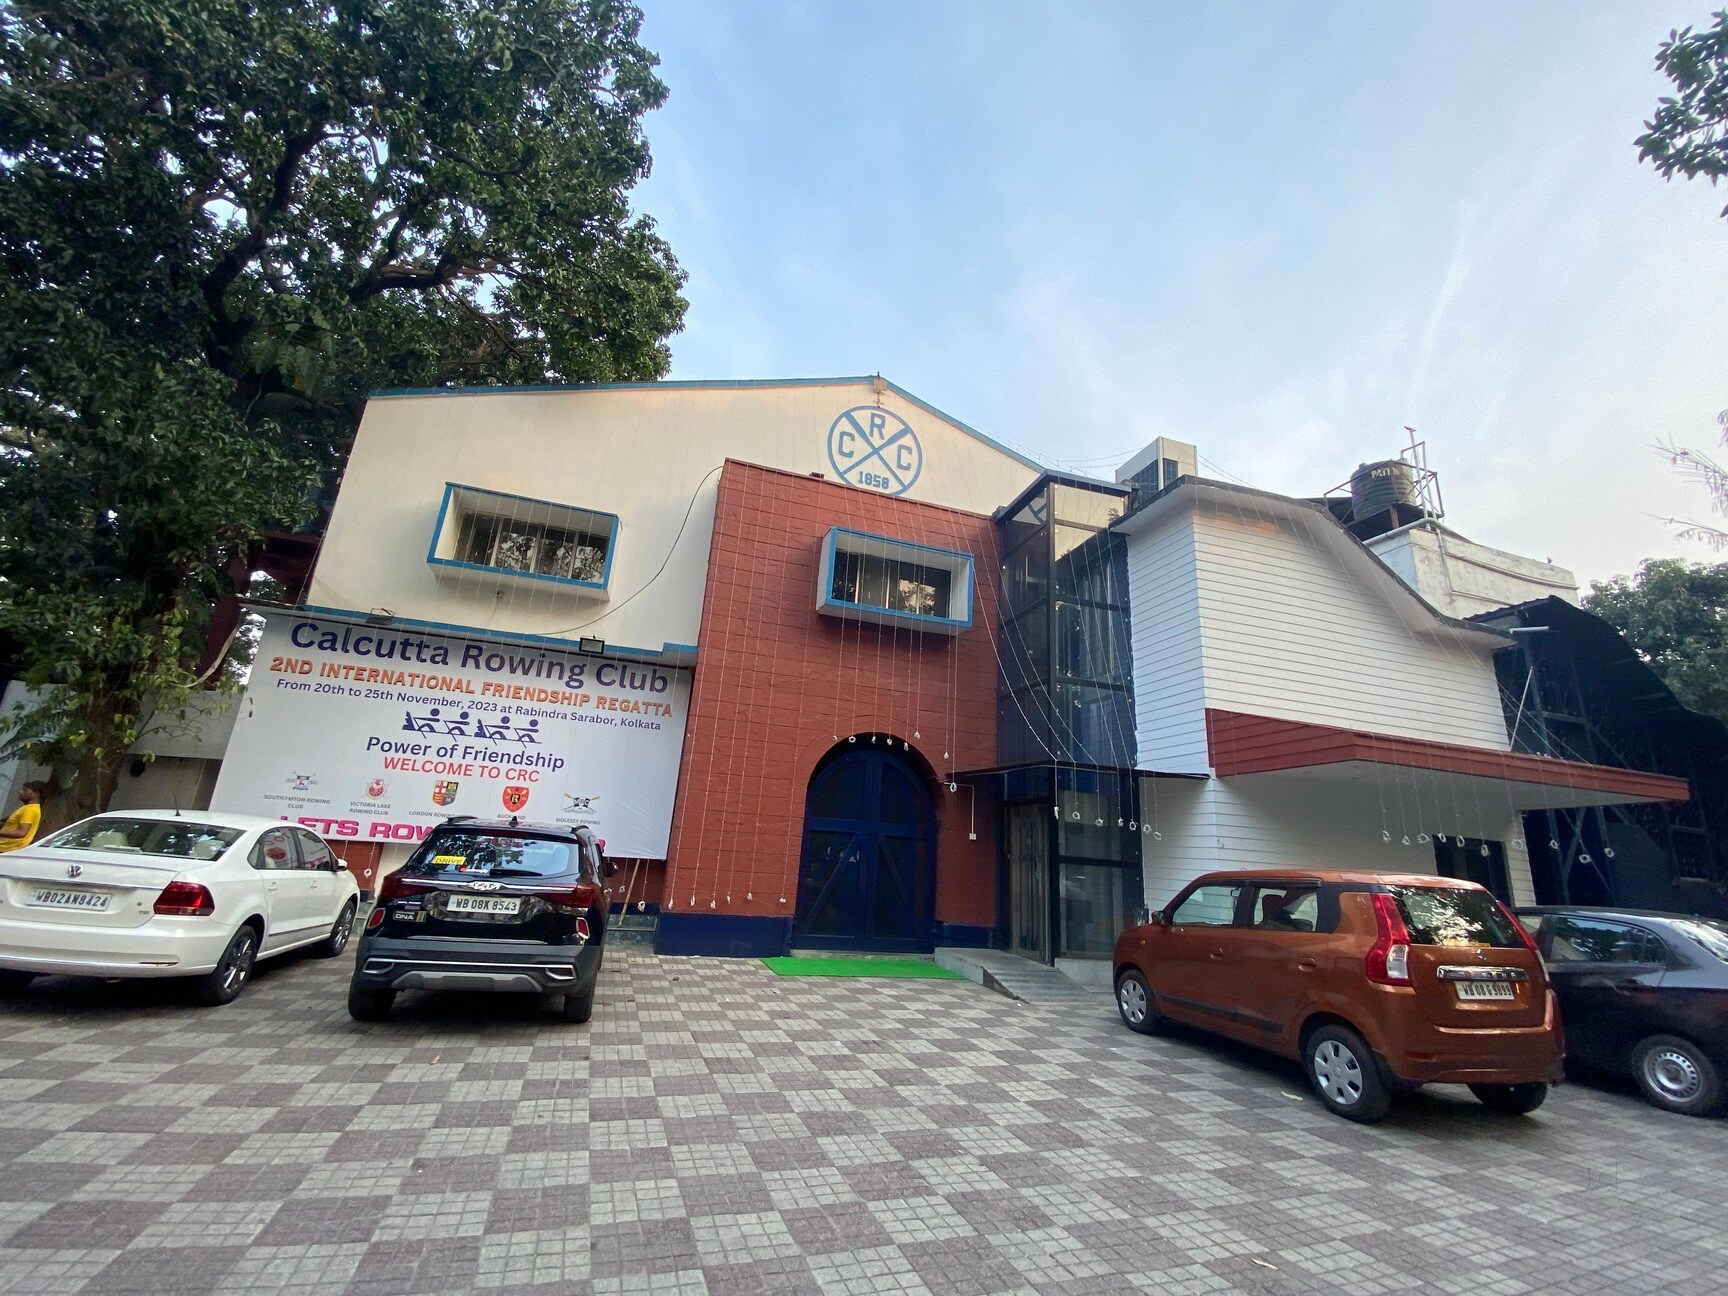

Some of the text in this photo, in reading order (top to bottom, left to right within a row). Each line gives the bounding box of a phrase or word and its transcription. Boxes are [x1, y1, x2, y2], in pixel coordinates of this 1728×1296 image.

[858, 471, 889, 489] 1858
[291, 622, 669, 693] Calcutta Rowing Club
[270, 656, 673, 717] 2ND INTERNATIONAL FRIENDSHIP REGATTA
[276, 679, 661, 730] From 20th to 25th November, 2023 at Rabindra Sarabor, Kolkata
[366, 736, 565, 772] Power of Friendship
[384, 756, 540, 783] WELCOME TO CRC
[280, 816, 359, 837] ETS
[455, 898, 517, 911] WB 08K 8543
